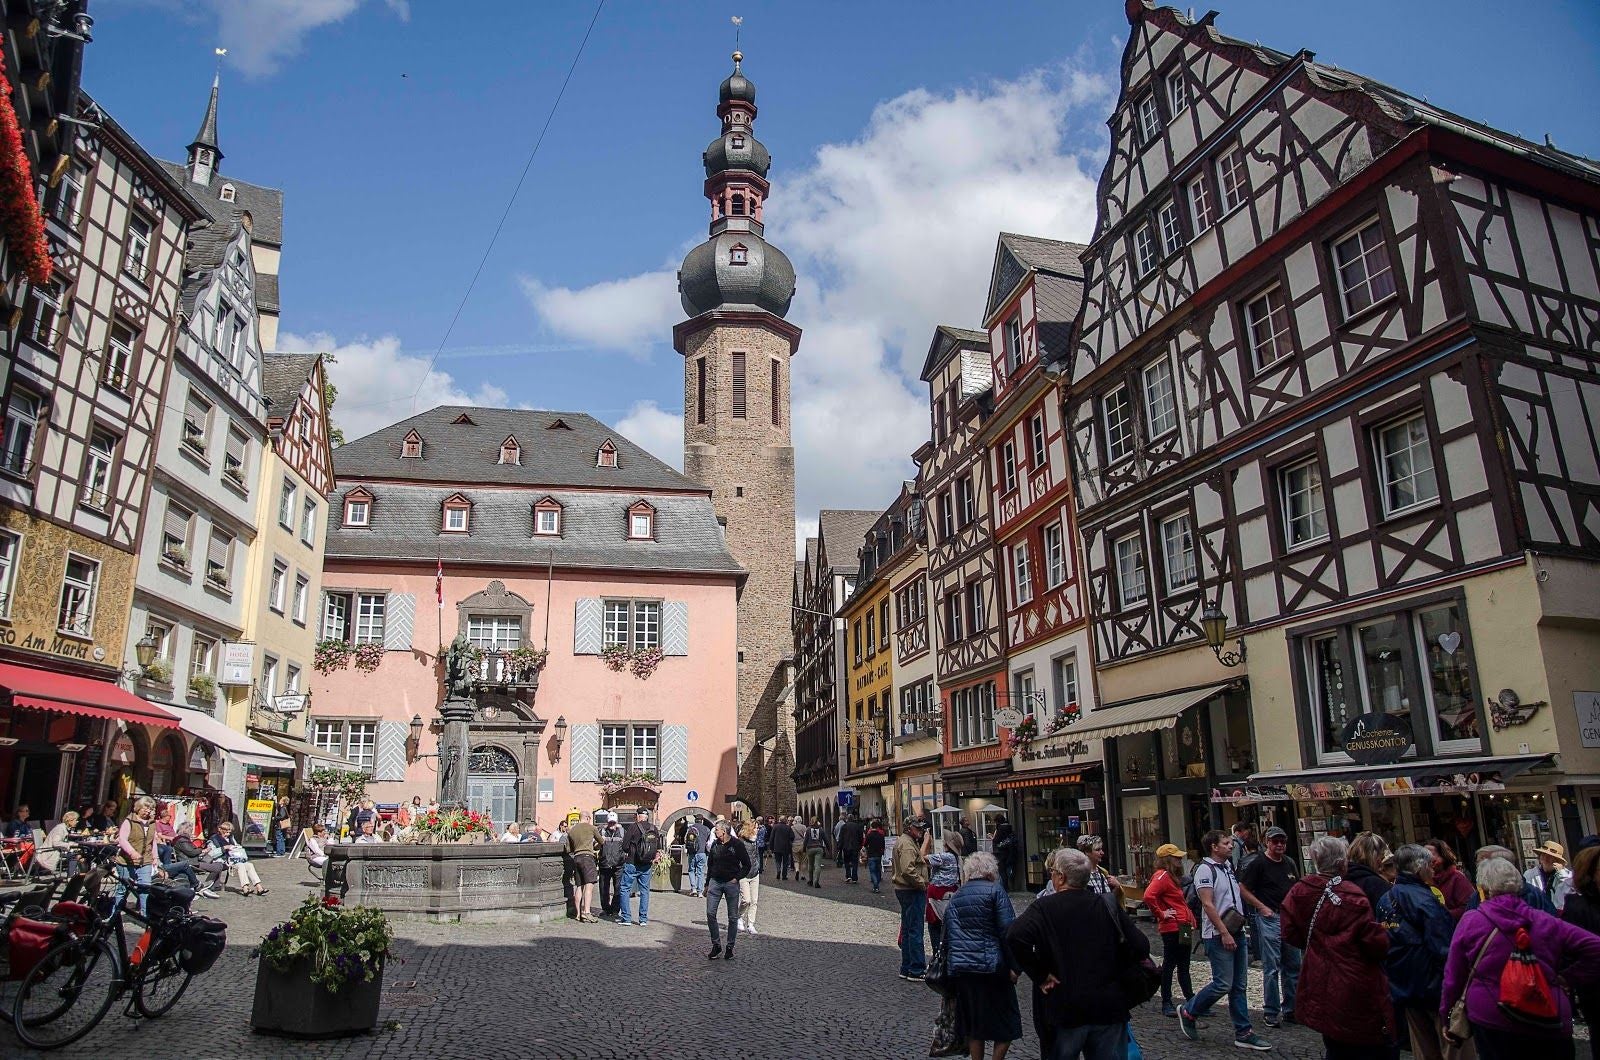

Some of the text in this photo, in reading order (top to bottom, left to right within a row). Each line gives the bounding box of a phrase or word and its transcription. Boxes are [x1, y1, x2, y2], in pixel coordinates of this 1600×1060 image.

[21, 631, 46, 651] Am
[48, 636, 89, 659] Markt
[1346, 737, 1407, 751] GENUSSKONTOR
